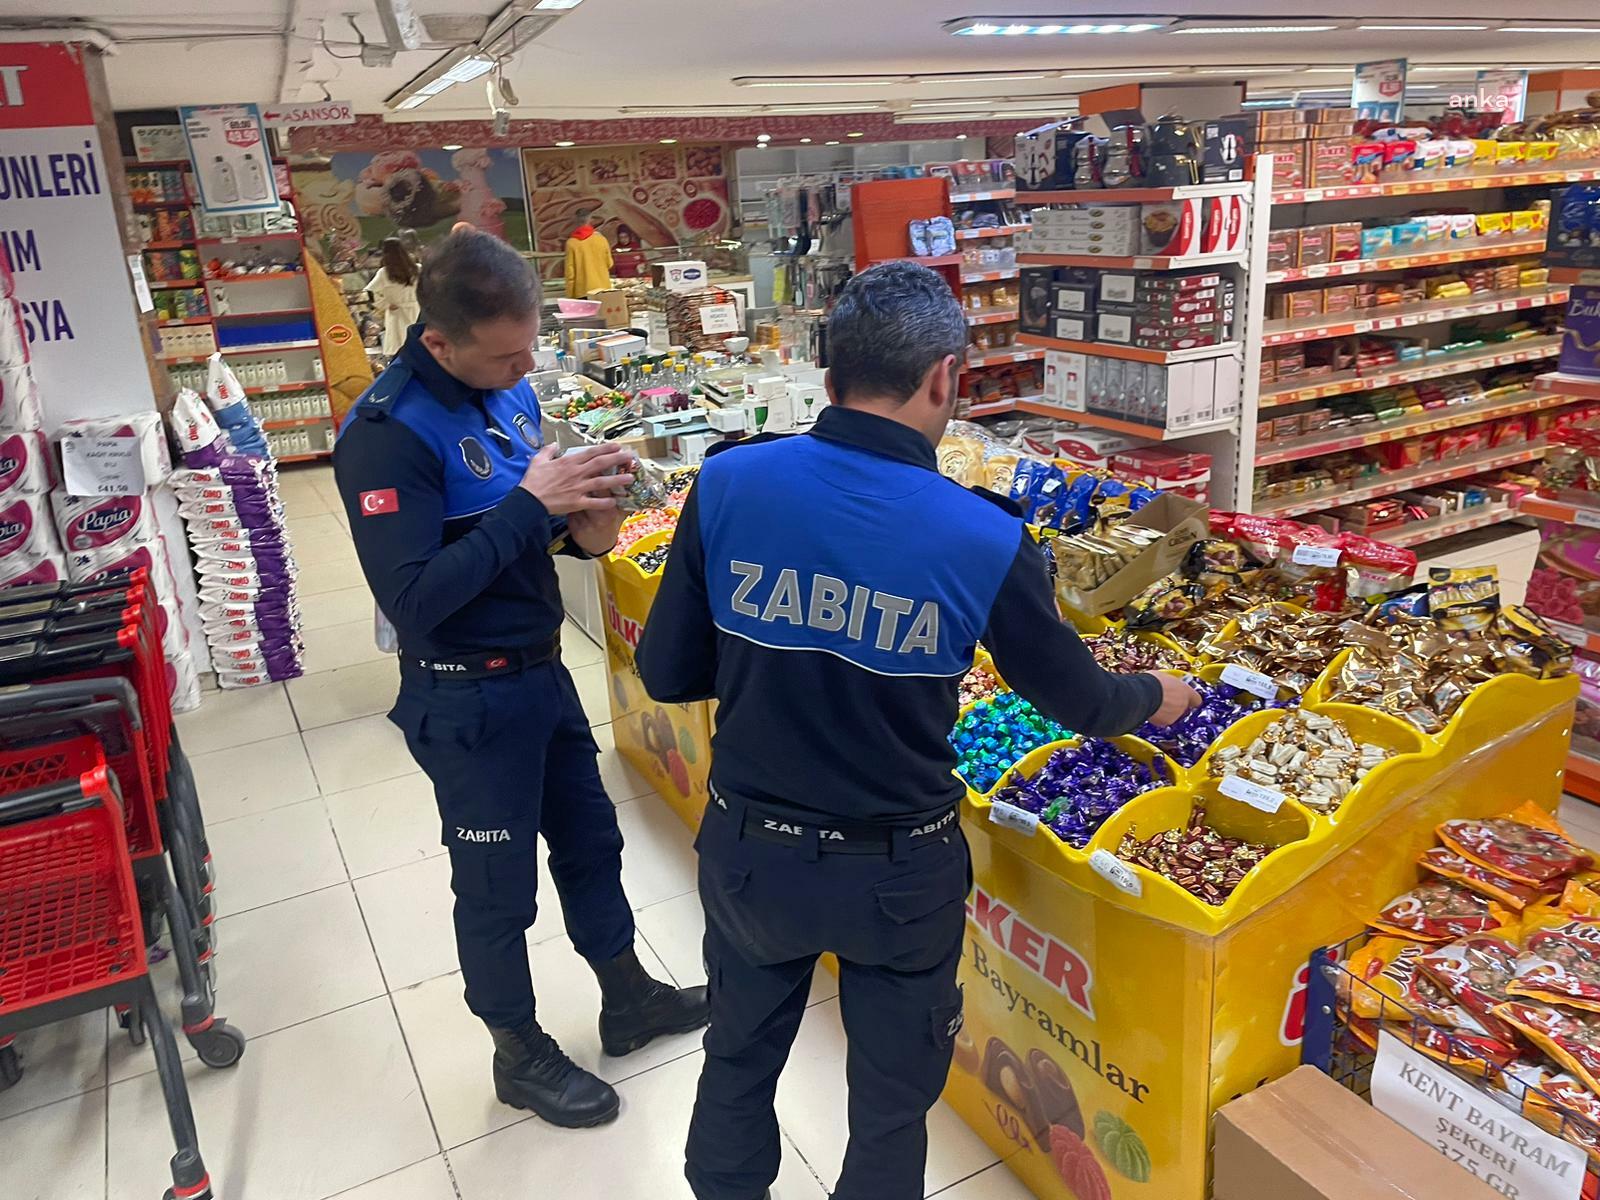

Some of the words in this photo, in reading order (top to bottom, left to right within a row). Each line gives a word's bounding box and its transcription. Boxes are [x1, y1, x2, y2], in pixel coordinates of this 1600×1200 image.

[81, 507, 131, 532] Papia
[730, 560, 938, 654] ZABITA
[419, 659, 467, 671] ZBITA
[456, 826, 511, 843] ZABITA
[764, 819, 845, 841] ZABTA
[909, 810, 955, 838] ABITA
[966, 884, 1096, 1021] KER
[971, 938, 1151, 1104] Bayramlar
[1399, 1062, 1463, 1112] KENT
[1465, 1105, 1571, 1178] BAYRAM
[1436, 1117, 1518, 1175] ŞEKERİ
[1436, 1139, 1480, 1176] 375
